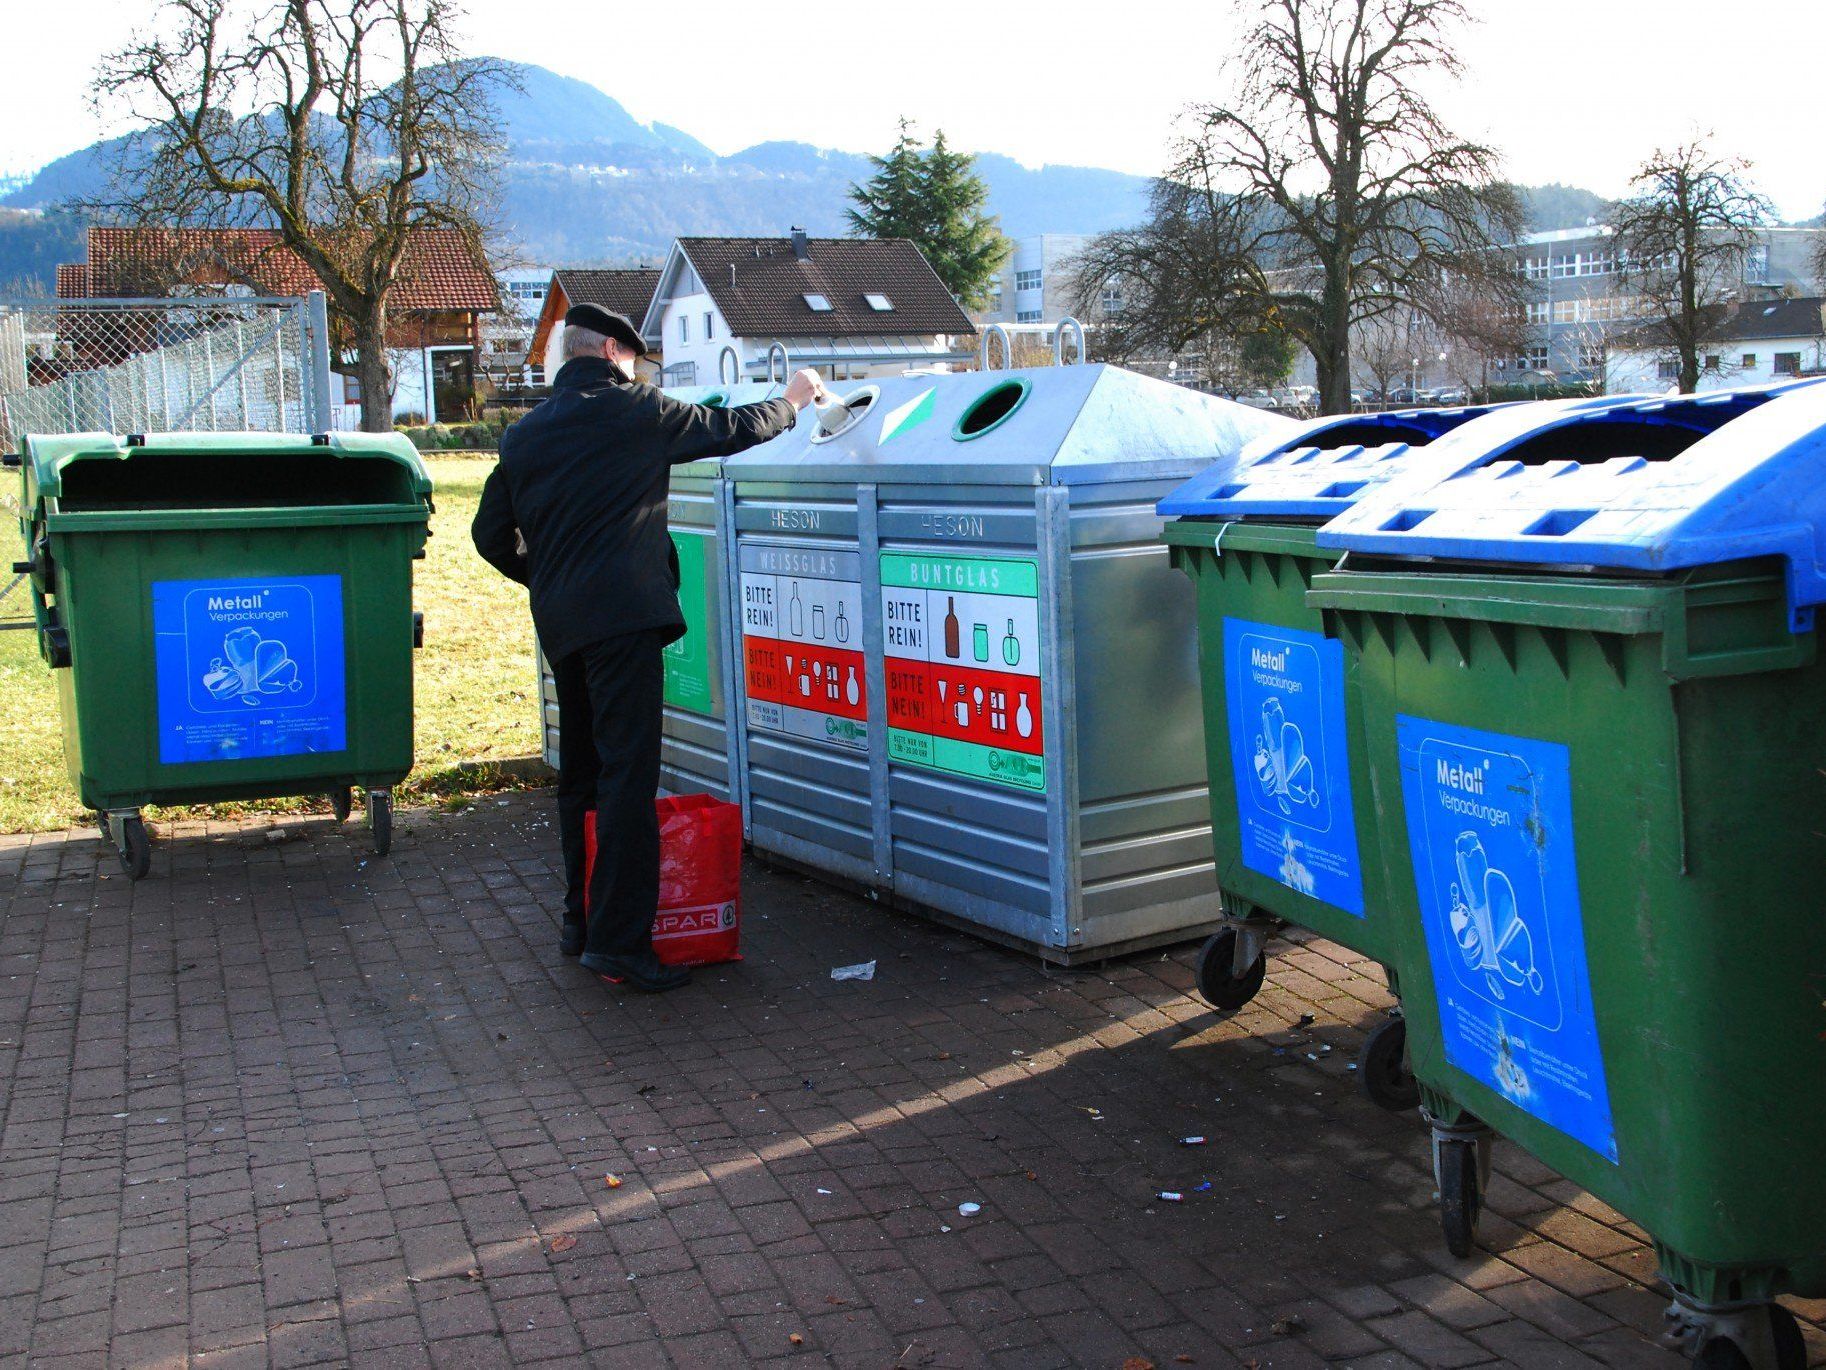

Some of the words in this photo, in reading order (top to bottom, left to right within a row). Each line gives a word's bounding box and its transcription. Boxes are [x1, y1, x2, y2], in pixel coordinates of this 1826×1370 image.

[771, 509, 820, 529] HESON
[760, 551, 836, 576] WEISSGLAS
[910, 562, 1001, 589] BUNTGLAS
[208, 594, 262, 611] Metall
[745, 585, 773, 605] BITTE
[209, 610, 289, 623] Verpackungen
[746, 607, 774, 628] REIN!
[887, 600, 922, 623] BITTE
[888, 625, 922, 648] REIN!
[748, 647, 775, 669] BITTE
[1251, 647, 1285, 673] Metall
[749, 669, 777, 692] NEIN!
[891, 671, 924, 695] BITTE
[1252, 669, 1303, 694] Verpackungen
[892, 697, 926, 721] NEIN!
[1437, 758, 1484, 796] Metall
[1438, 789, 1511, 827] Verpackungen
